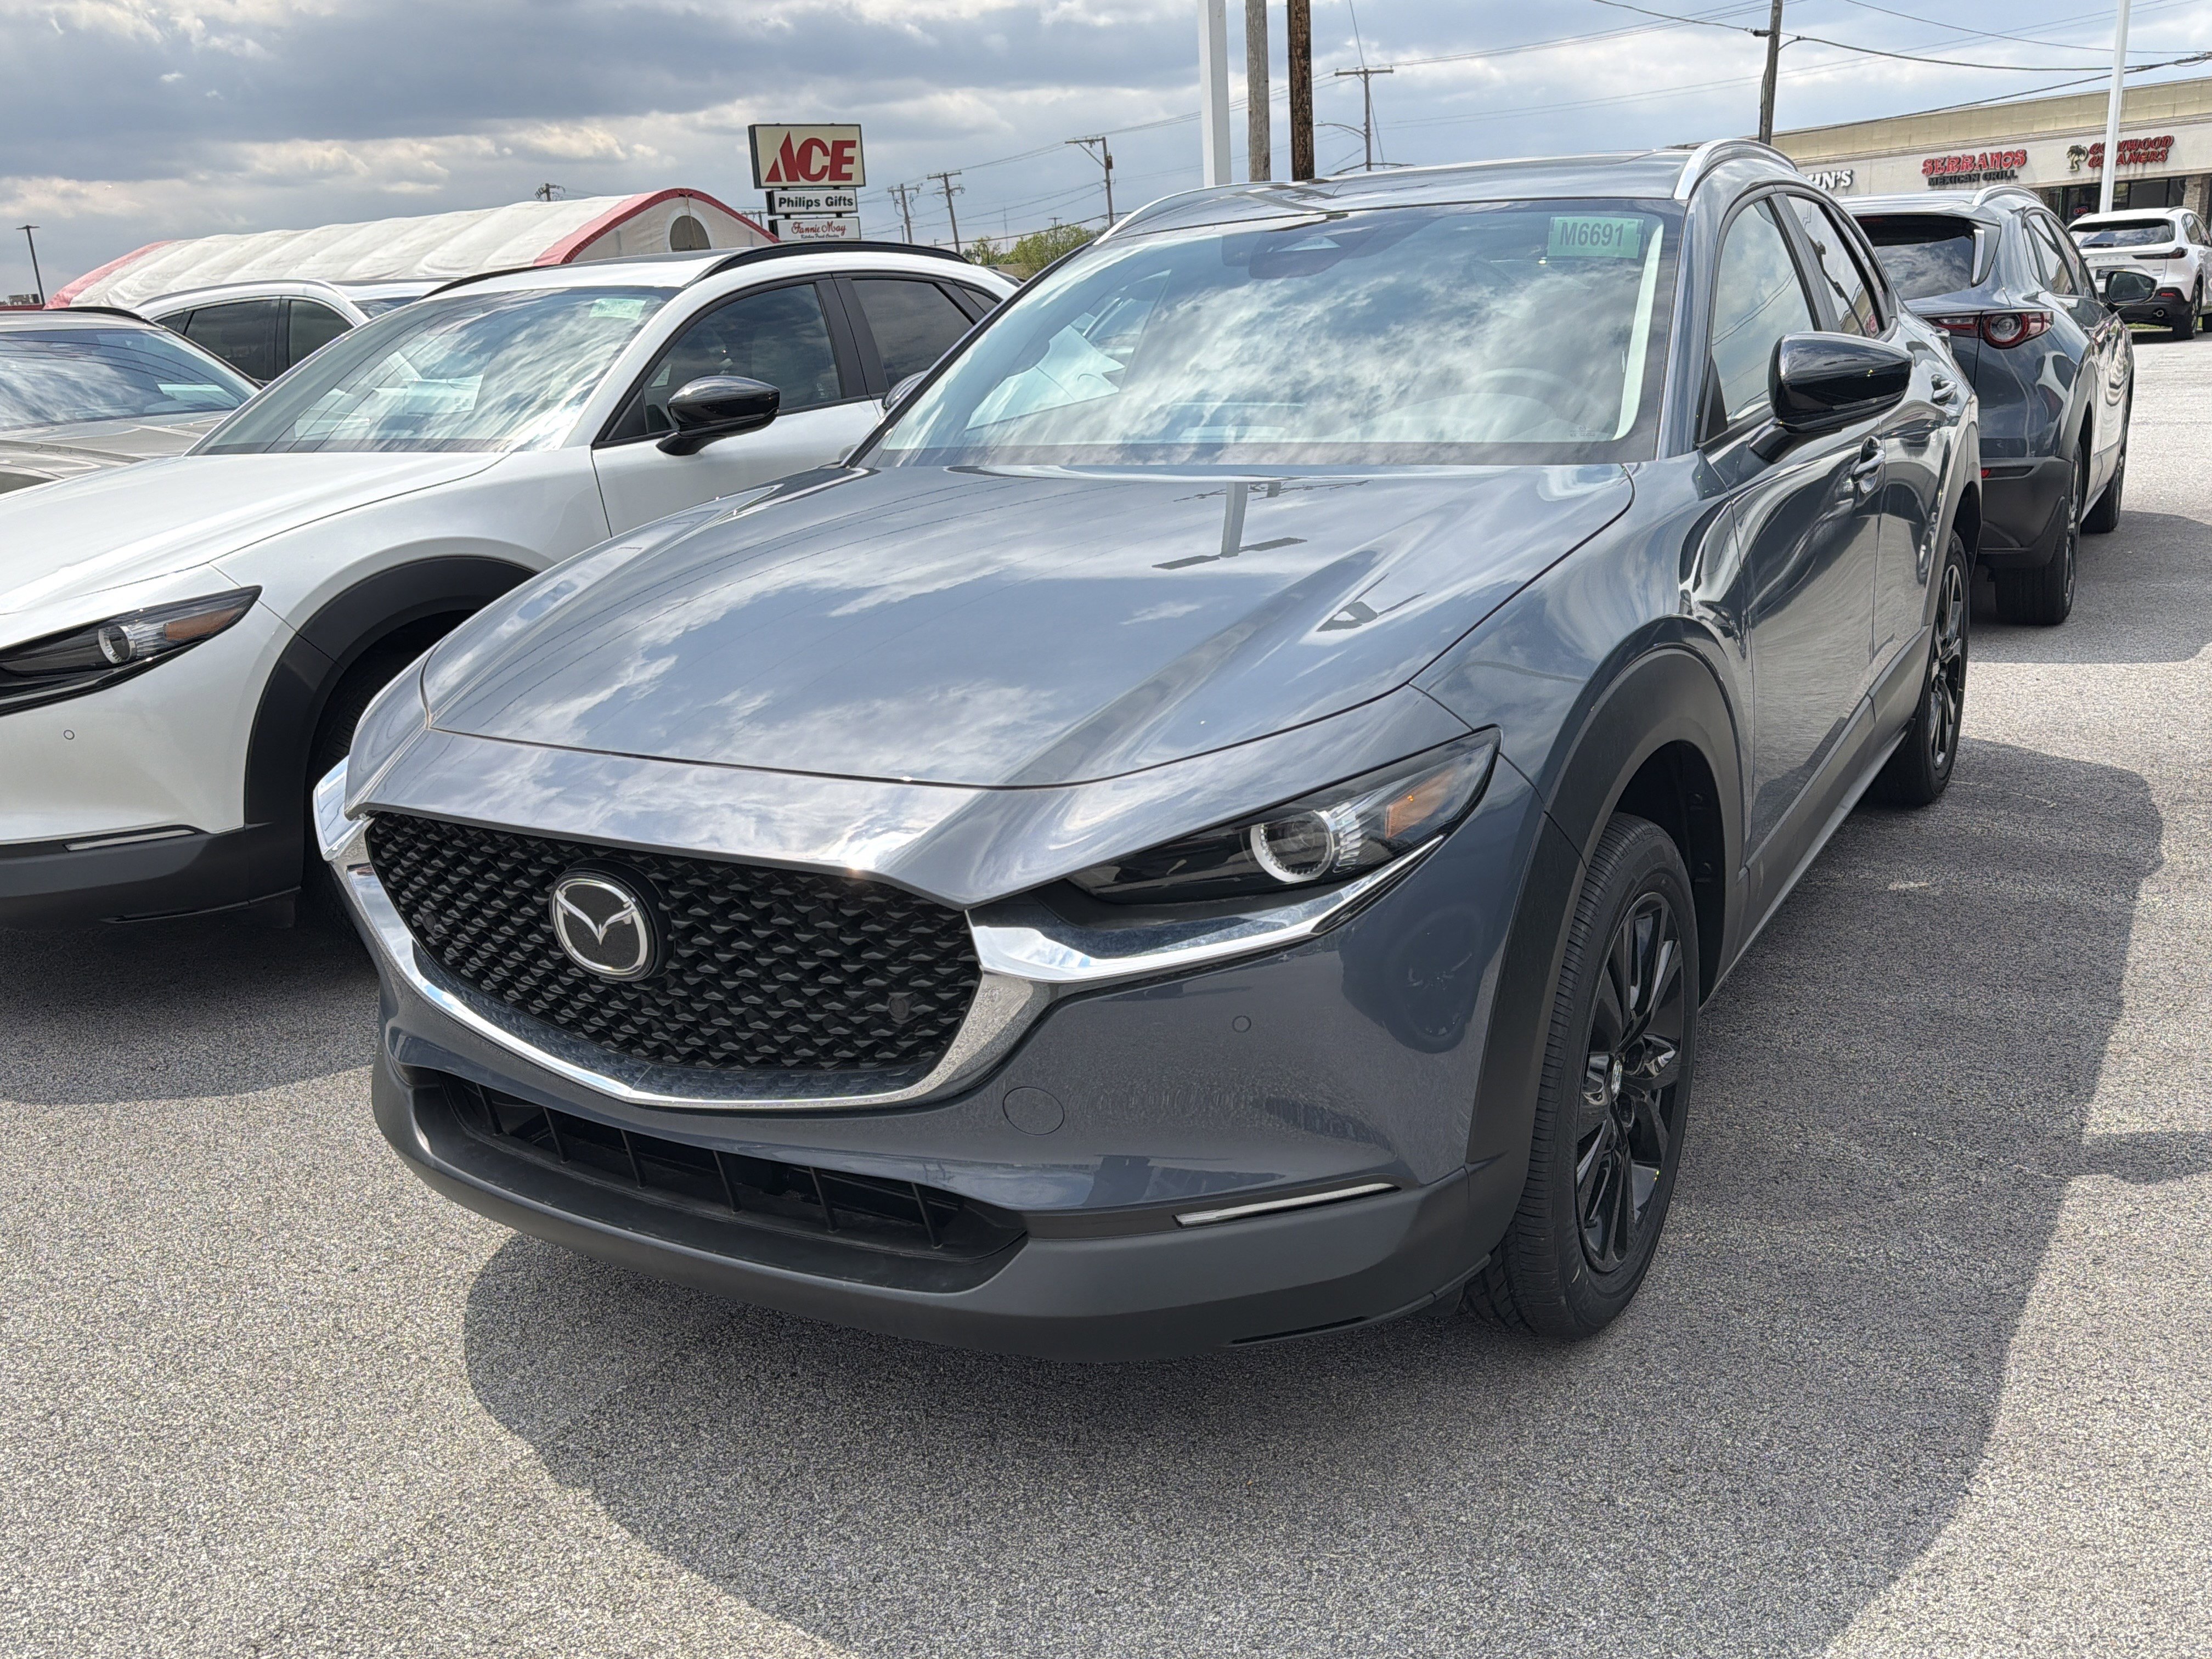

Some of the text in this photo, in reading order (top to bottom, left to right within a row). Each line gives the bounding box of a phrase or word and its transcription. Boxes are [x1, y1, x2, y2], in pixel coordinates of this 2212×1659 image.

[765, 131, 856, 182] ACE
[1922, 149, 2027, 176] SERRANOS
[2088, 149, 2169, 168] CLANERS
[1928, 170, 2018, 186] MEXICAN GRILL
[778, 196, 854, 210] Philips Gifts
[791, 221, 846, 236] Fannie May
[1560, 222, 1624, 246] M6691
